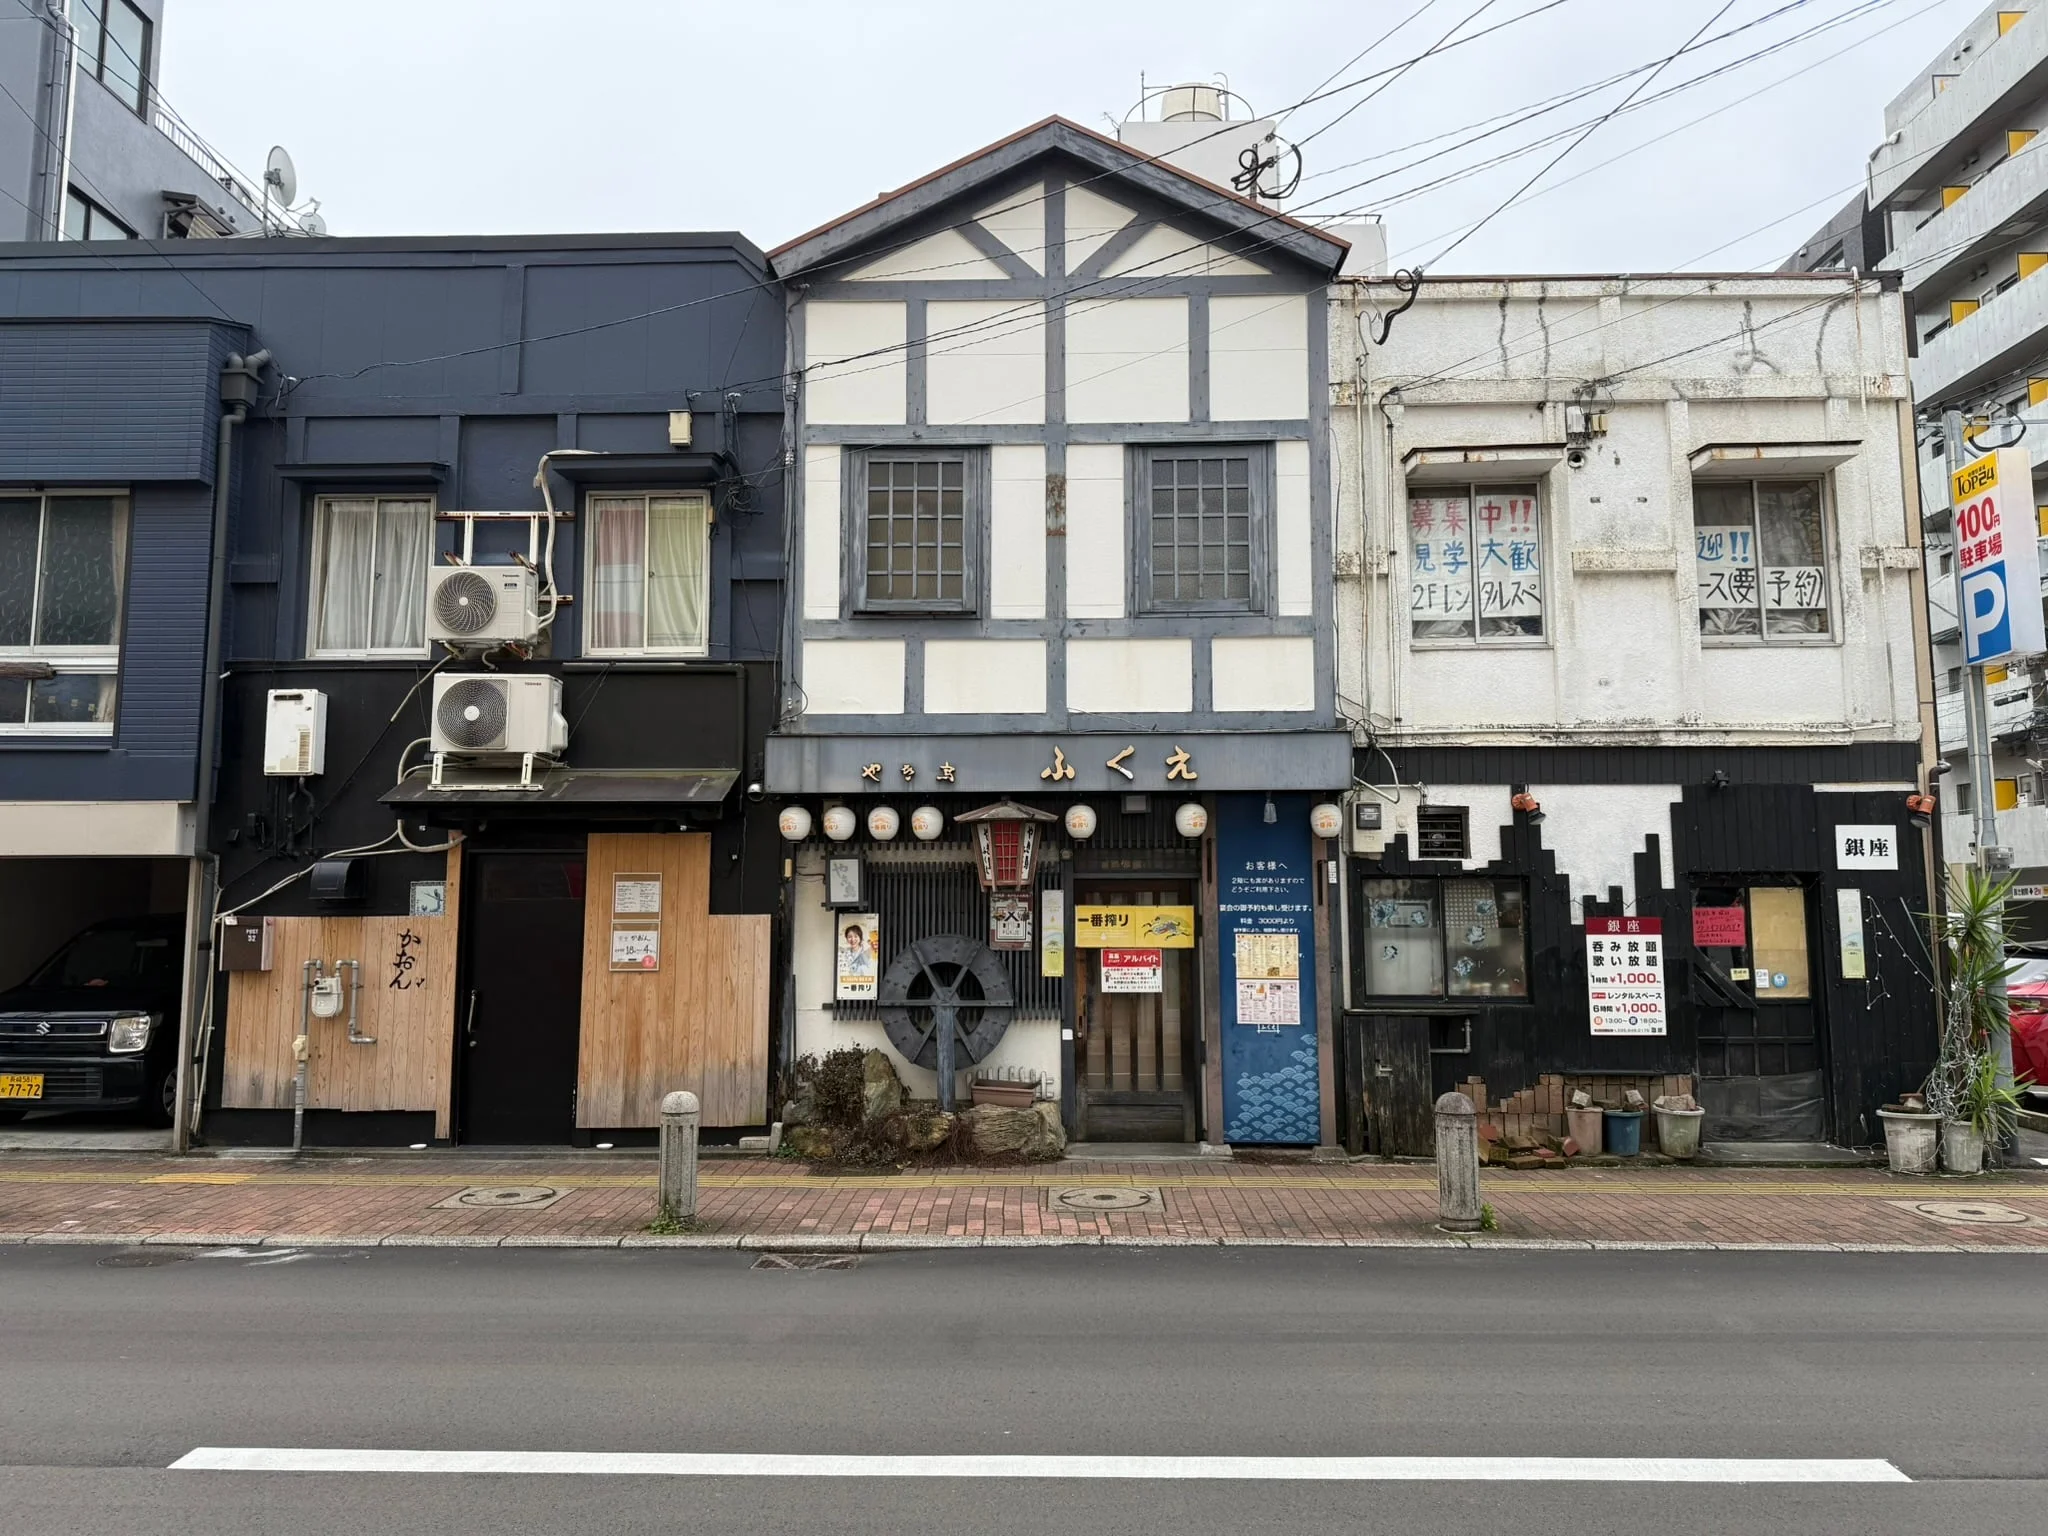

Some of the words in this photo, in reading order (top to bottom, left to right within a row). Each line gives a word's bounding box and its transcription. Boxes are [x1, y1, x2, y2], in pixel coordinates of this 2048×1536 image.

[1959, 532, 2003, 571] 駐車場
[1962, 570, 2006, 660] P
[1040, 745, 1198, 781] ふくえ
[1845, 838, 1889, 857] 銀座
[1245, 861, 1288, 871] お客様へ
[1077, 913, 1129, 927] 一番搾り
[1607, 919, 1641, 932] 銀座
[1592, 941, 1657, 953] 呑み放題
[1123, 954, 1159, 963] アルバイト
[1593, 955, 1658, 967] 歌い放題
[1607, 992, 1663, 1000] レンタルスペース
[9, 1083, 41, 1096] 77-72
